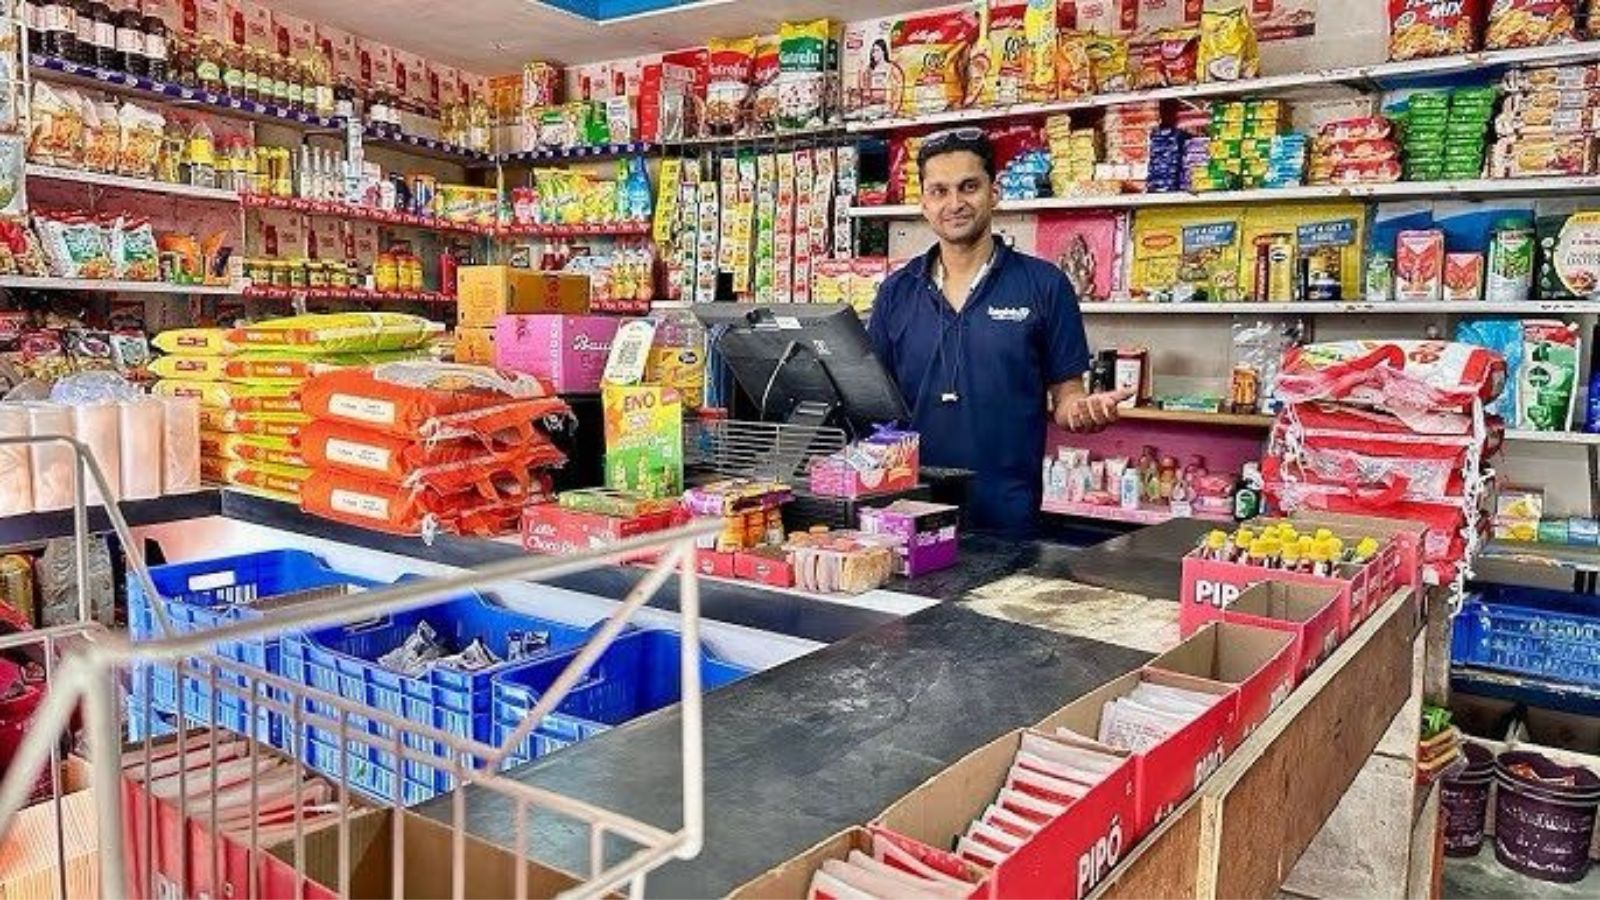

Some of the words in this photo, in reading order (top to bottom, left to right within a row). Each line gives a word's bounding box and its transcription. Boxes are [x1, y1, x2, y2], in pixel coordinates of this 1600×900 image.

[624, 392, 656, 412] ENO
[1195, 580, 1241, 607] PIP
[1077, 815, 1123, 899] PIPÓ
